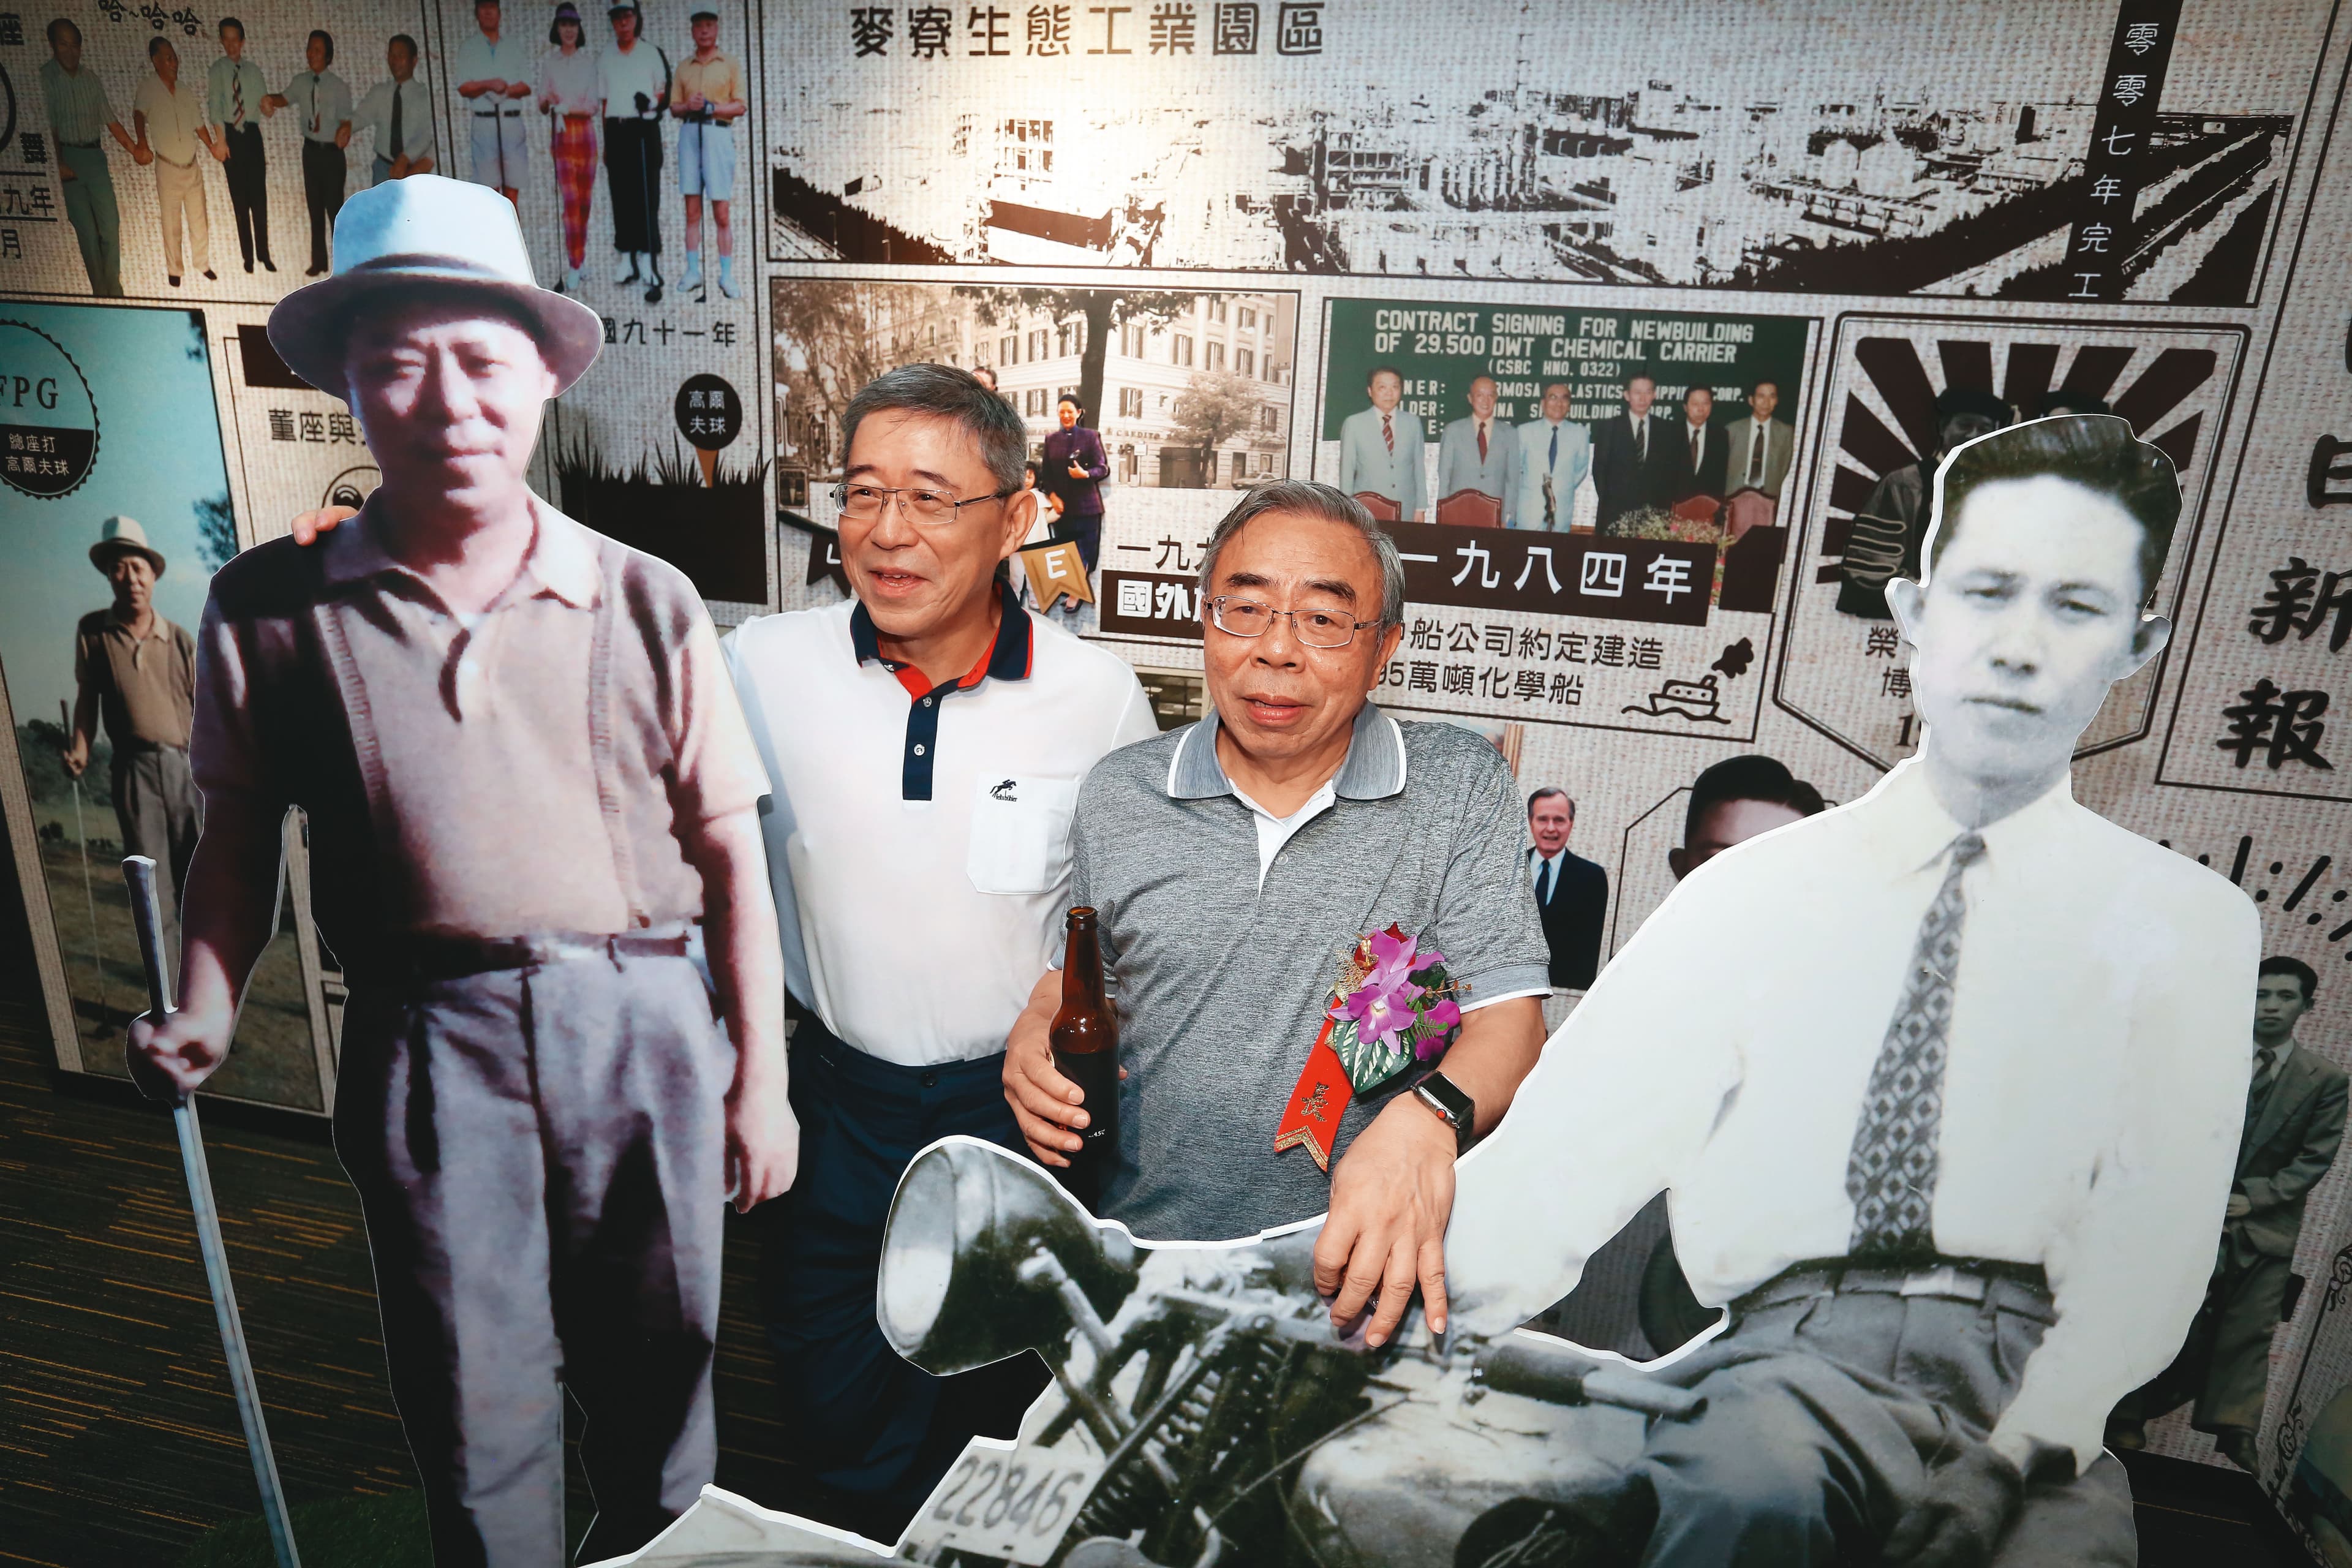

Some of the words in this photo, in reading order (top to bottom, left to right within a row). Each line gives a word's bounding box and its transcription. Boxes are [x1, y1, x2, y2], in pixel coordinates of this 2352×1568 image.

[850, 2, 1325, 58] 麥寮生態工業園區
[2068, 23, 2160, 298] 零零七年完工
[1, 228, 21, 259] 月
[1375, 309, 1479, 333] CONTRACT
[1492, 313, 1566, 335] SIGNING
[1580, 317, 1618, 337] FOR
[1630, 320, 1754, 343] NEWBUILDING
[1375, 333, 1402, 353] OF
[1491, 336, 1536, 357] DWT
[1551, 337, 1646, 360] CHEMICAL
[1660, 342, 1737, 363] CARRIER
[1488, 358, 1532, 375] (CSBC
[1580, 362, 1621, 377] 0322)
[9, 432, 56, 453] 總座打
[268, 408, 366, 446] 董座與
[5, 456, 70, 477] 高爾夫球
[2216, 311, 2352, 771] 日新報
[1044, 548, 1068, 579] E
[1400, 540, 1694, 605] 一九八四年
[1865, 625, 1899, 658] 榮
[933, 1454, 1085, 1537] 22846
